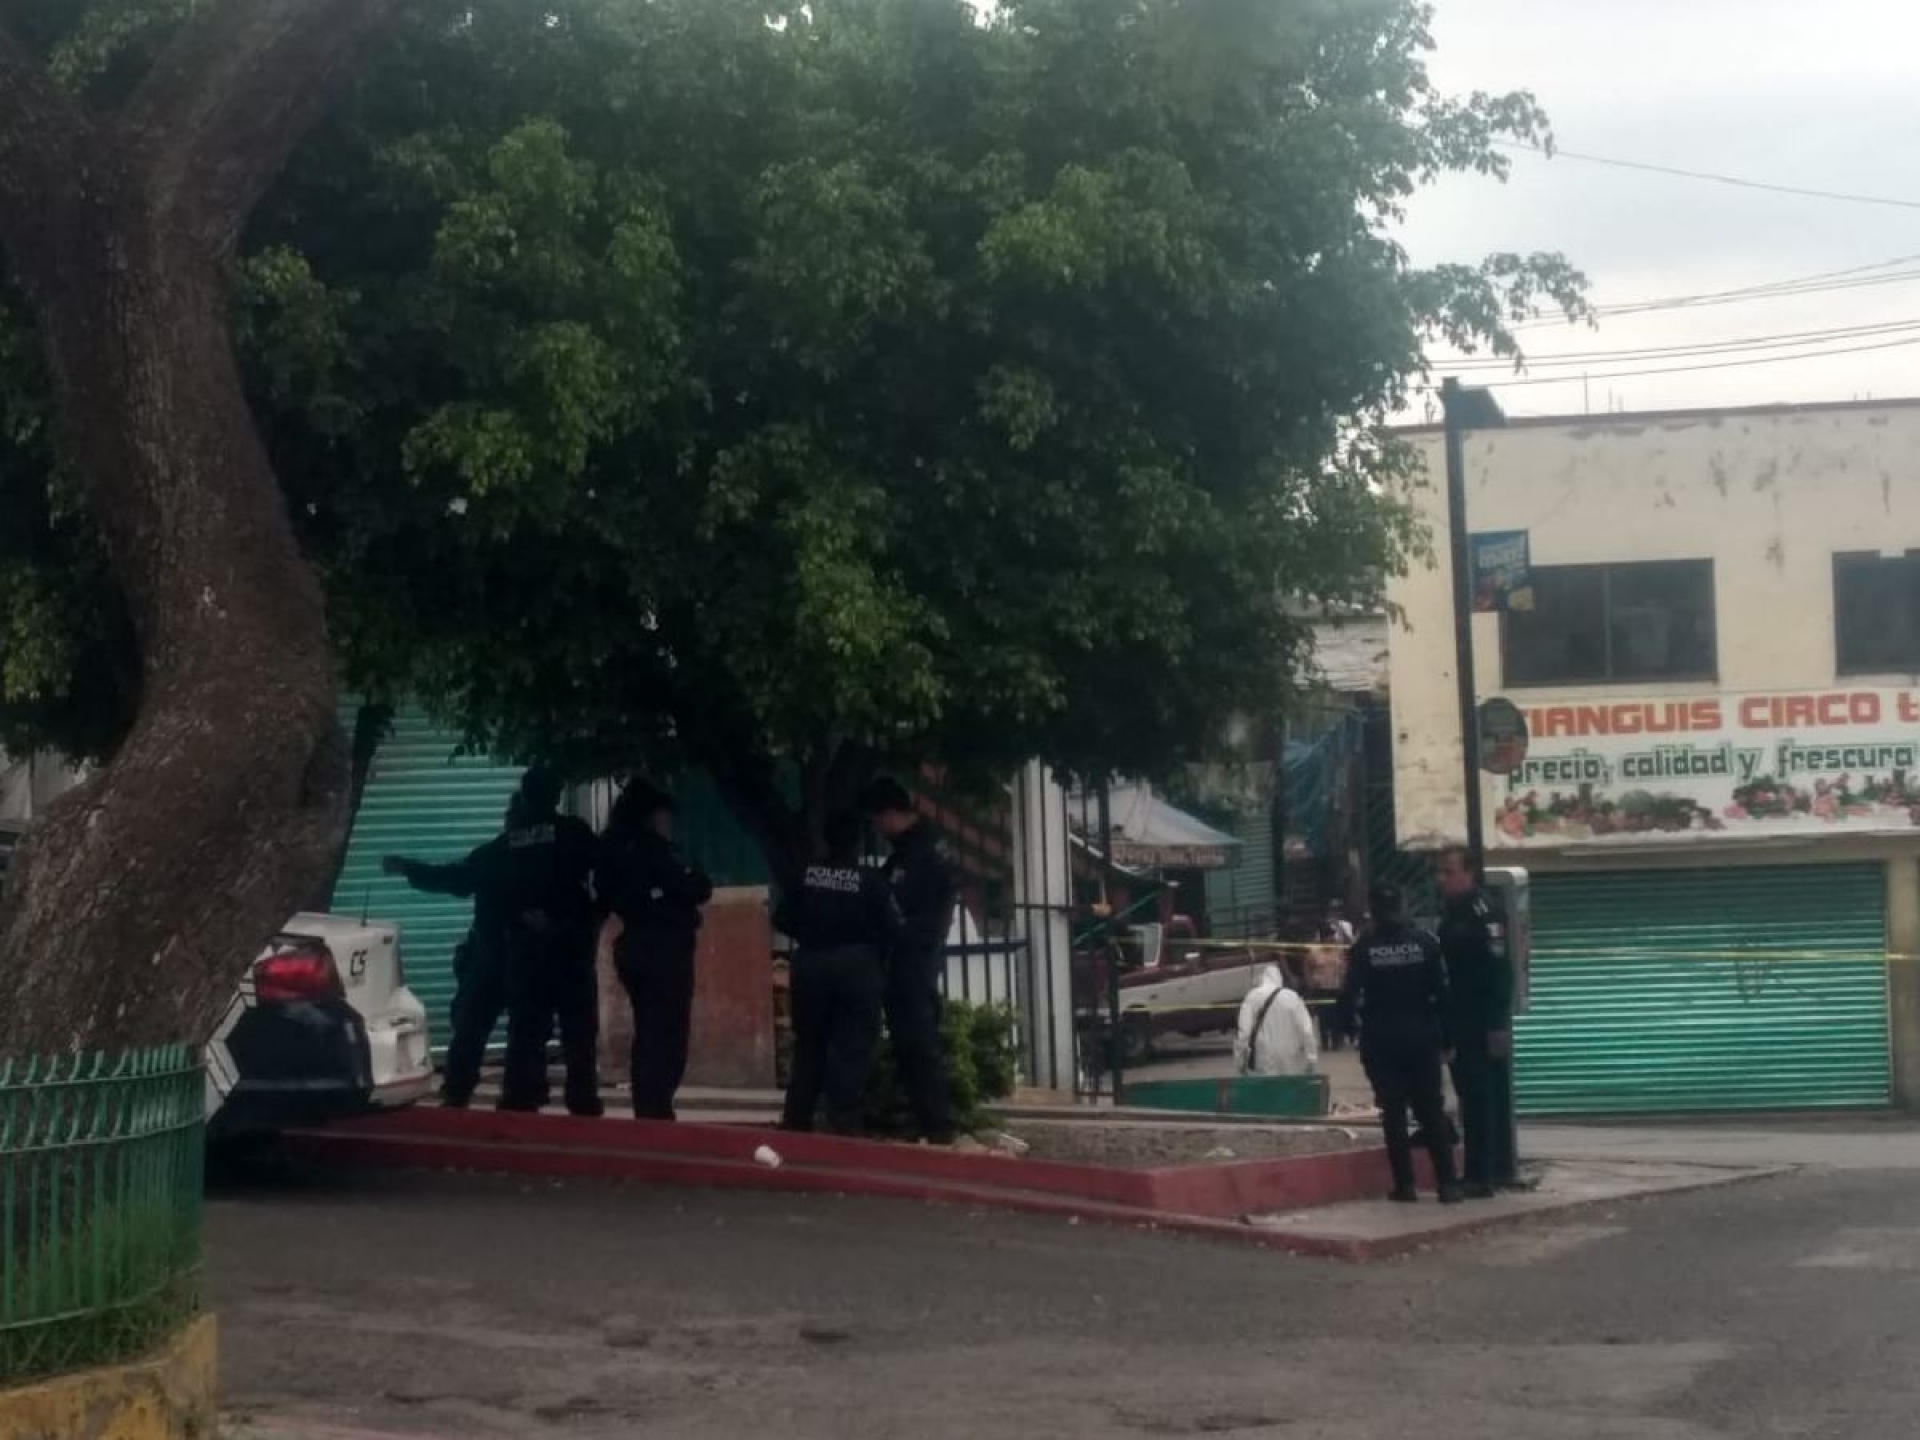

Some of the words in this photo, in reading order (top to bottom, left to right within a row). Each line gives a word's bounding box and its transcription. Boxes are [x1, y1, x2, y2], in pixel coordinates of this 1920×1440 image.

[1739, 692, 1880, 728] CIRCO
[1622, 745, 1728, 777] calidad
[1738, 752, 1757, 780] y
[1777, 743, 1914, 778] frescura
